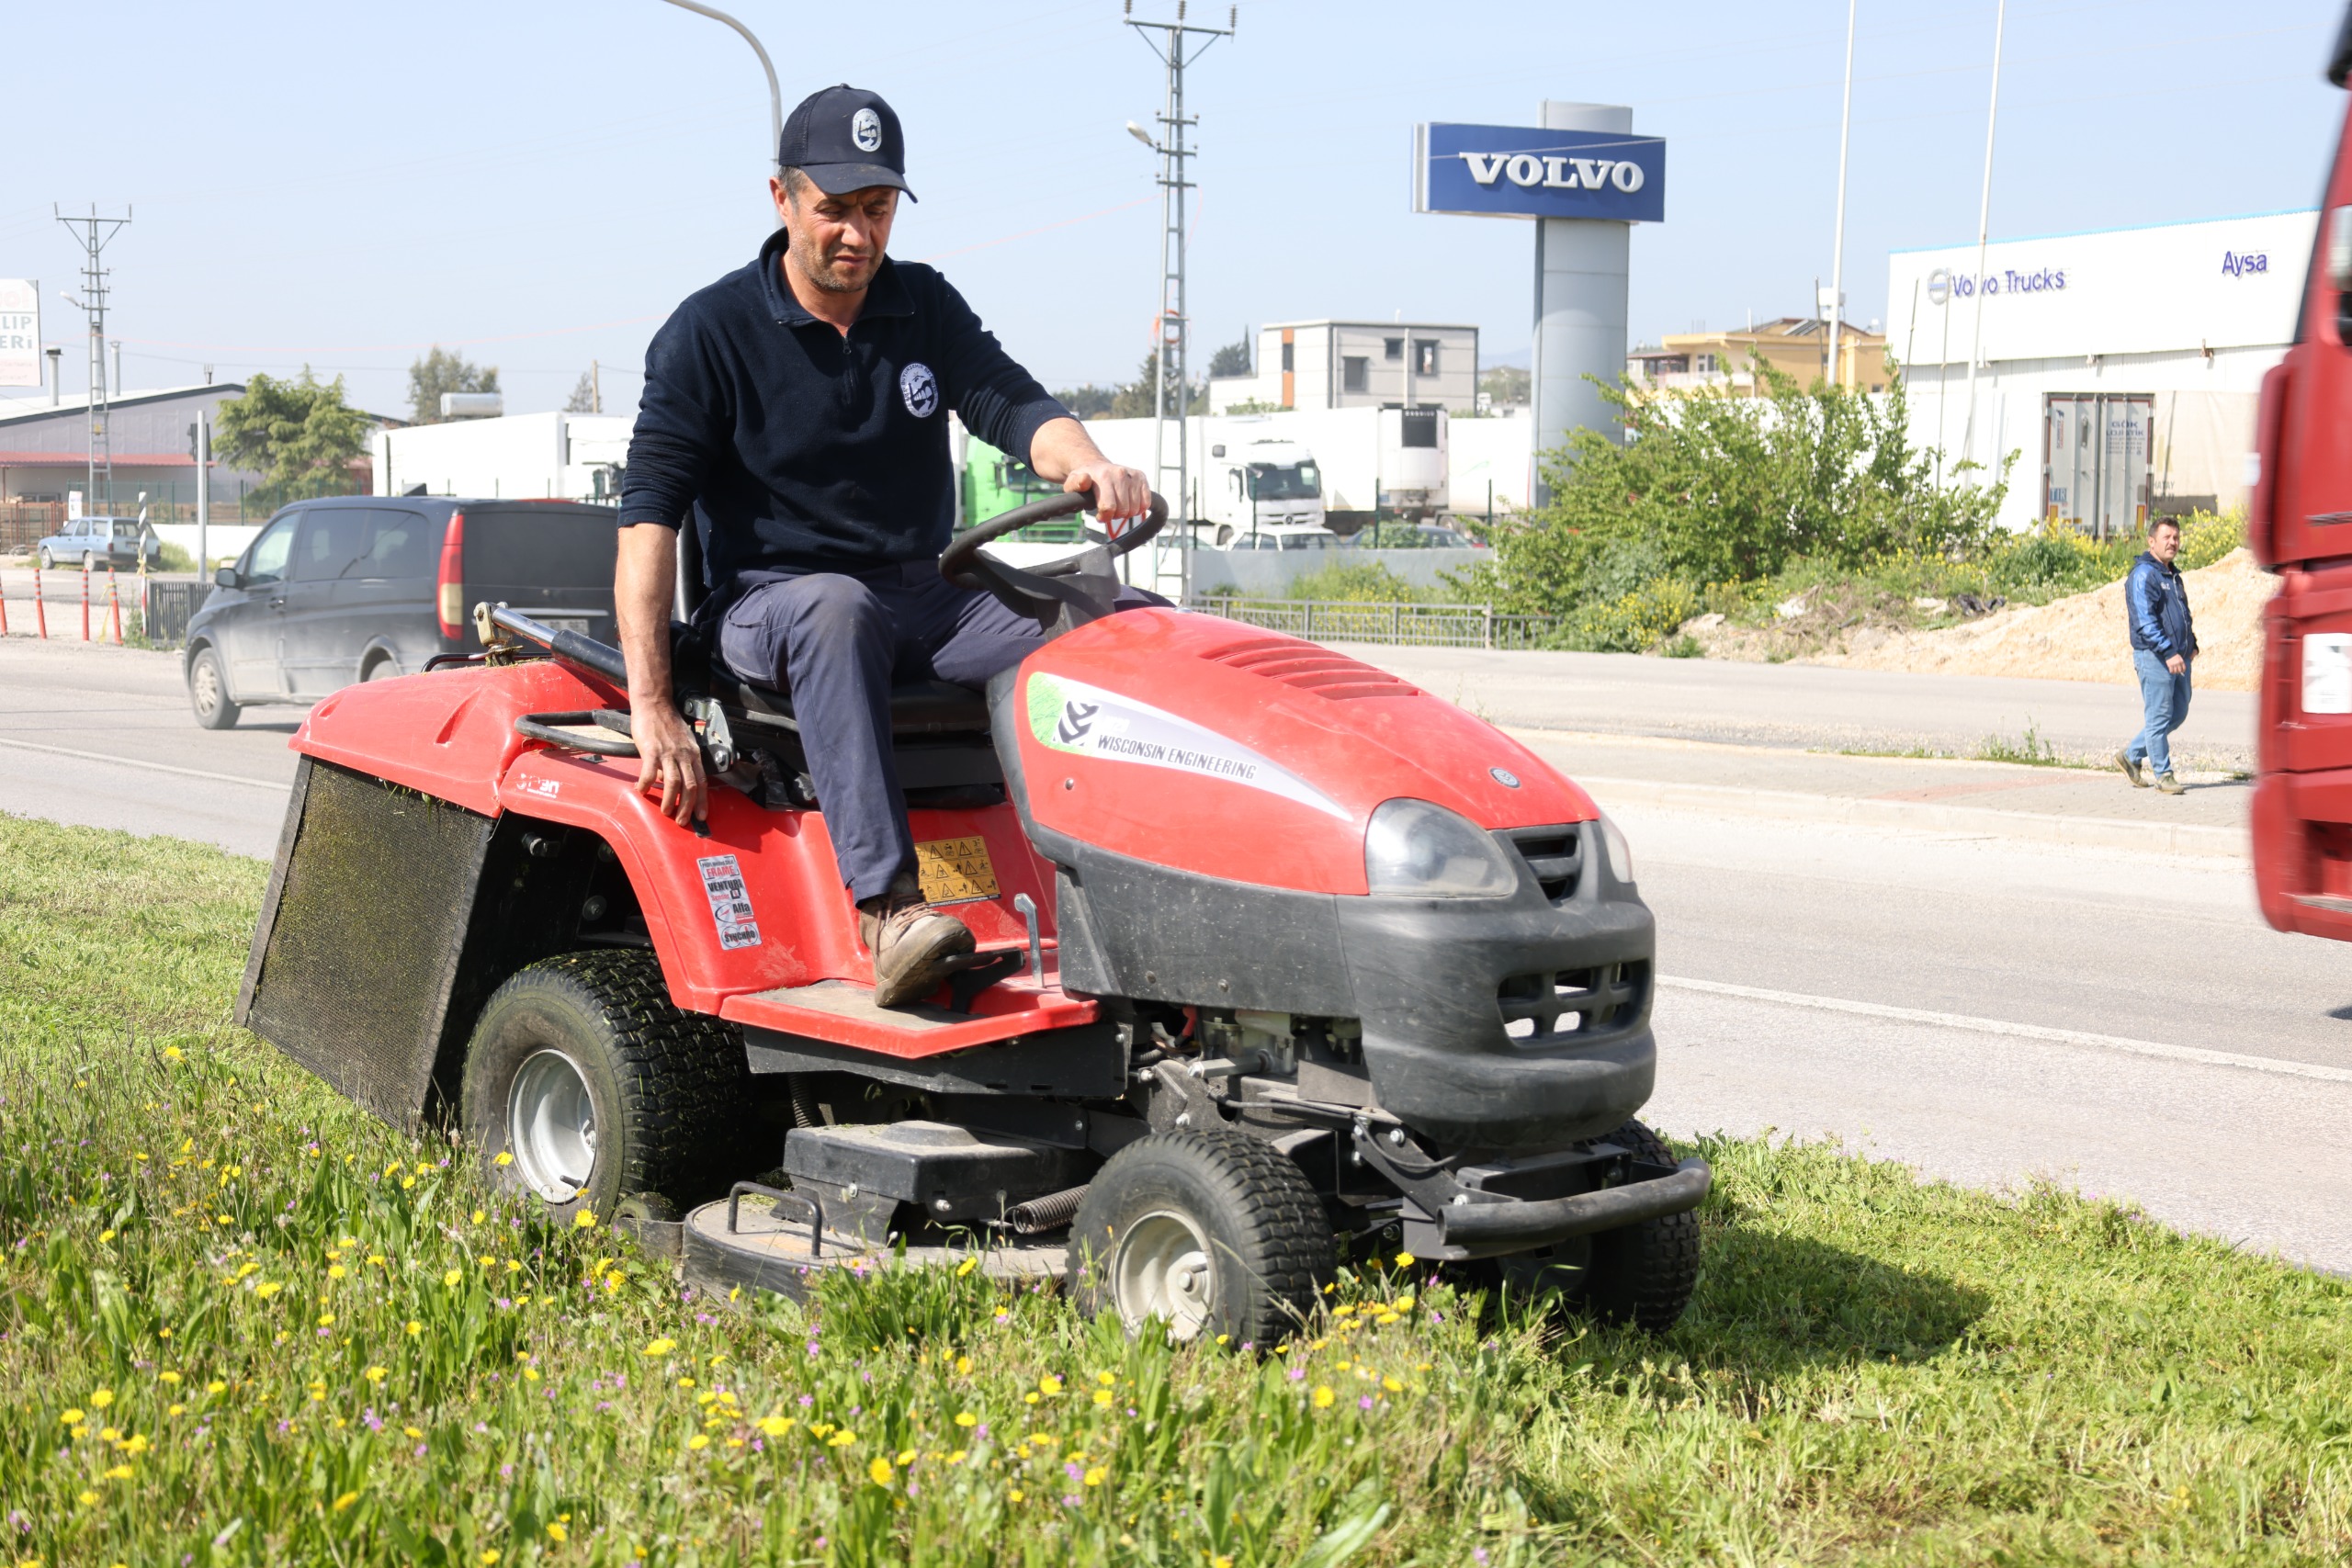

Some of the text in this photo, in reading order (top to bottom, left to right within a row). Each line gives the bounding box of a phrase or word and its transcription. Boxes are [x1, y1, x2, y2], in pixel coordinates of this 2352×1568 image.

[1459, 152, 1645, 193] VOLVO
[2222, 250, 2267, 277] Aysa
[2006, 266, 2065, 294] Trucks
[0, 316, 32, 330] LIP
[2050, 489, 2066, 501] TIR
[1097, 734, 1257, 780] WISCONSIN ENGINEERING
[707, 866, 735, 877] FRAME
[732, 903, 751, 914] Alfa
[724, 931, 755, 942] SYNCHRO
